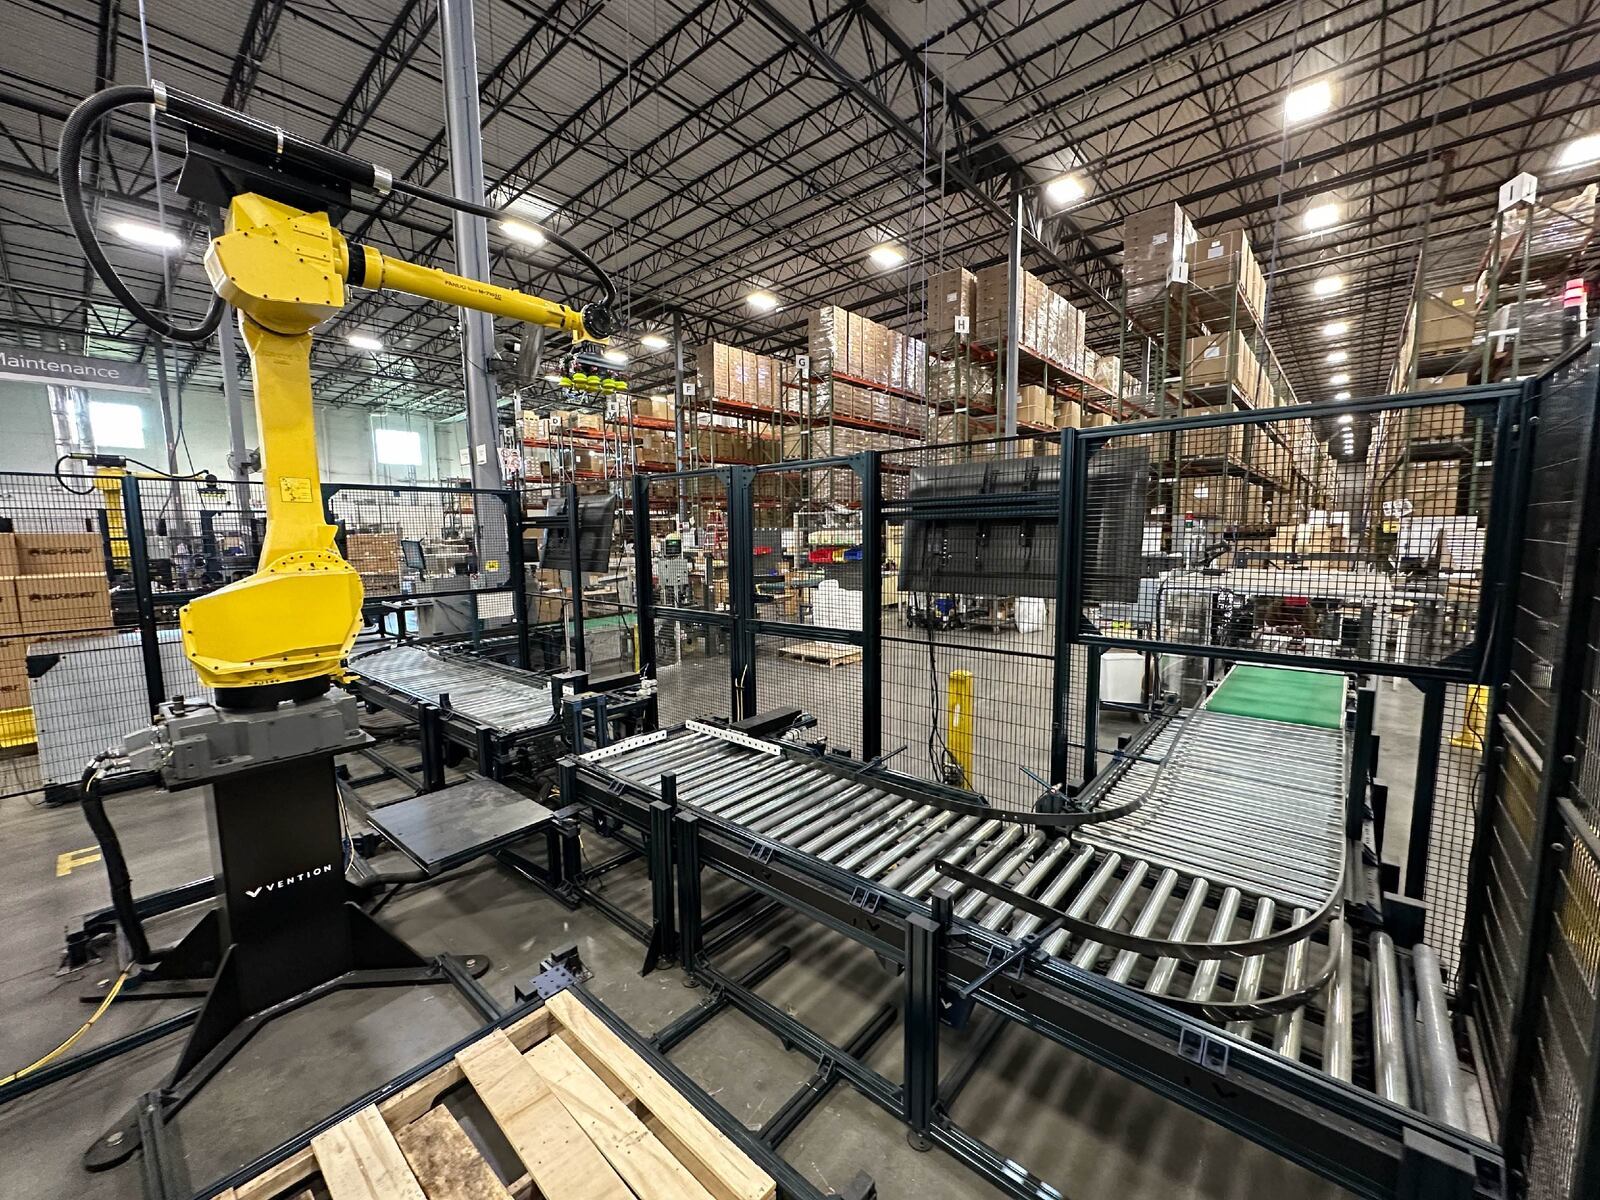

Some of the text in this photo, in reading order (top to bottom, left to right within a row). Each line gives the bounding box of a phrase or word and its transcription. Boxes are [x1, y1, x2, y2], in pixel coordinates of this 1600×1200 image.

[958, 319, 965, 330] H
[798, 358, 806, 367] G
[266, 864, 332, 892] VENTION
